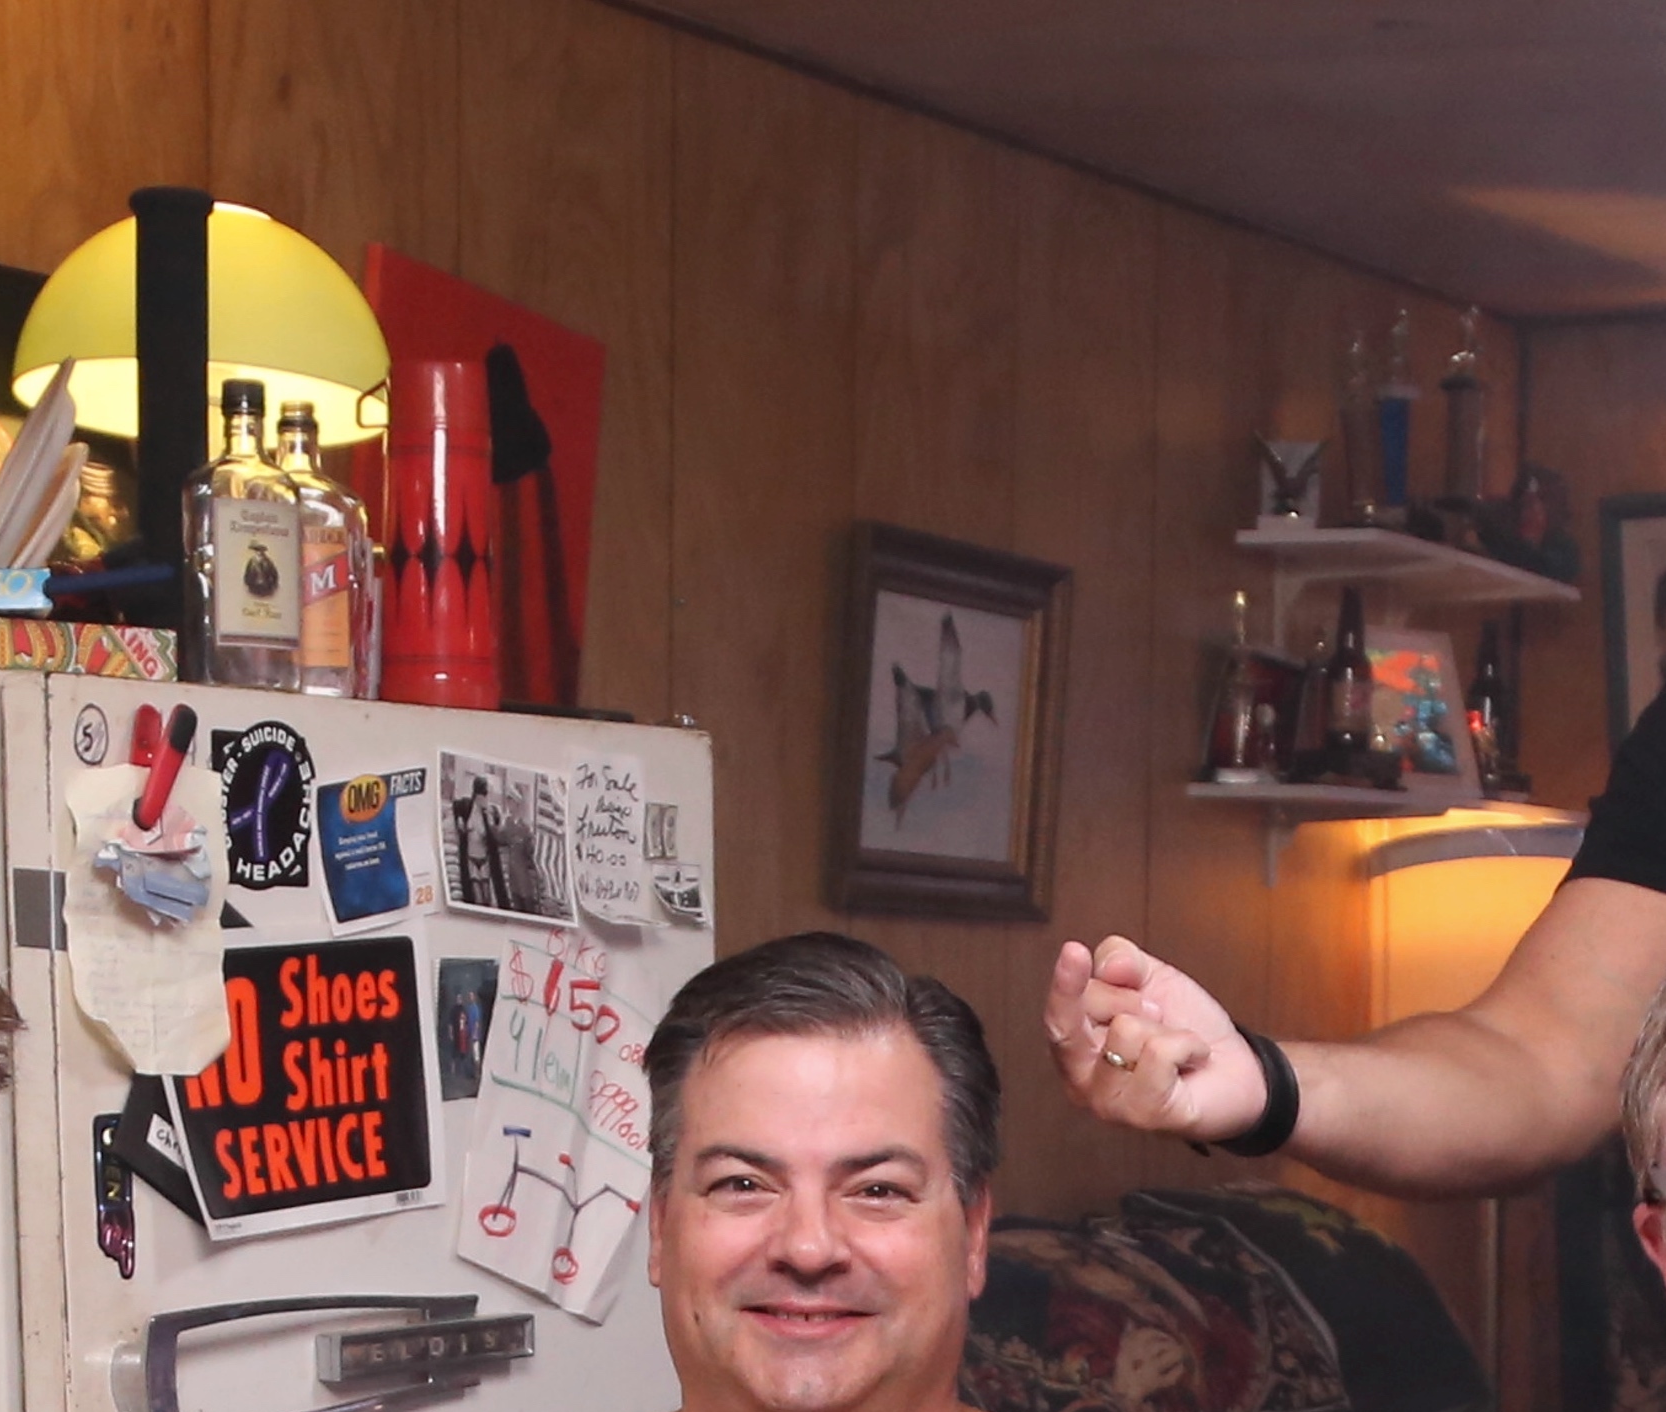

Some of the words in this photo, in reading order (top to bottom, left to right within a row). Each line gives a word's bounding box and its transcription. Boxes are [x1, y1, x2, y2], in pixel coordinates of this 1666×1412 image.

[120, 628, 159, 678] ING
[241, 726, 296, 753] SUICIDE
[236, 760, 313, 881] HEADACHE
[347, 780, 381, 814] OMG
[389, 771, 423, 796] FACTS
[279, 954, 401, 1029] Shoes
[282, 1037, 389, 1111] Shirt
[214, 1110, 388, 1200] SERVICE
